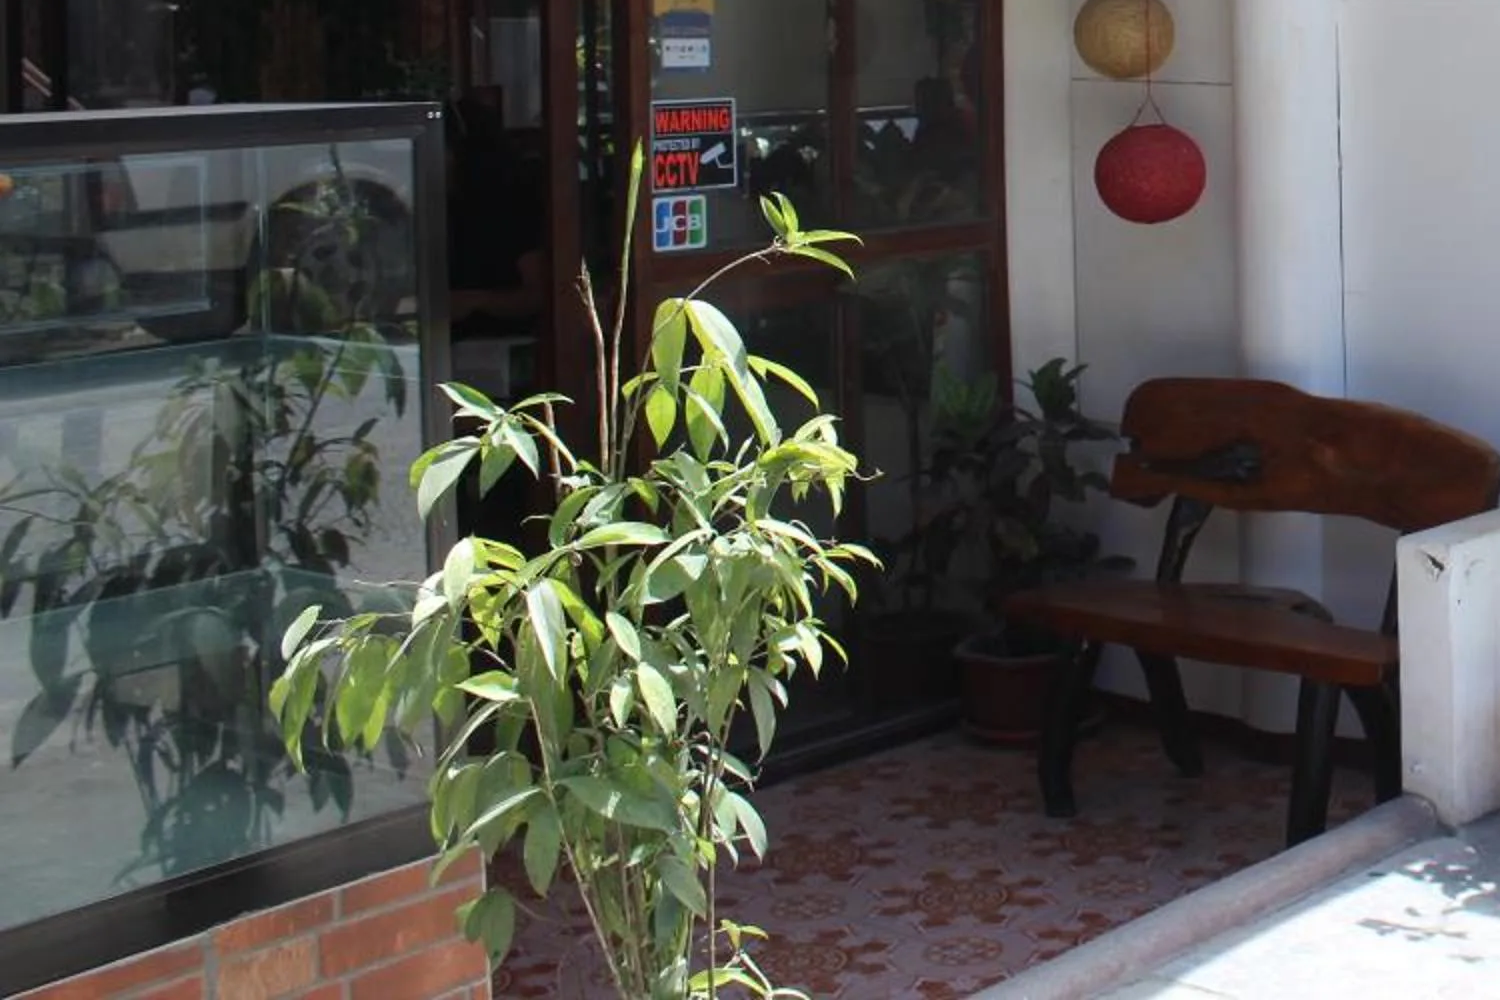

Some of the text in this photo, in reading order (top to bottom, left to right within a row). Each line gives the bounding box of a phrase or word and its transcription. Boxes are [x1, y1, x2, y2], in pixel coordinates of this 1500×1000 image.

[655, 108, 730, 133] WARNING
[655, 152, 699, 187] CCTV
[655, 213, 702, 233] JCB
